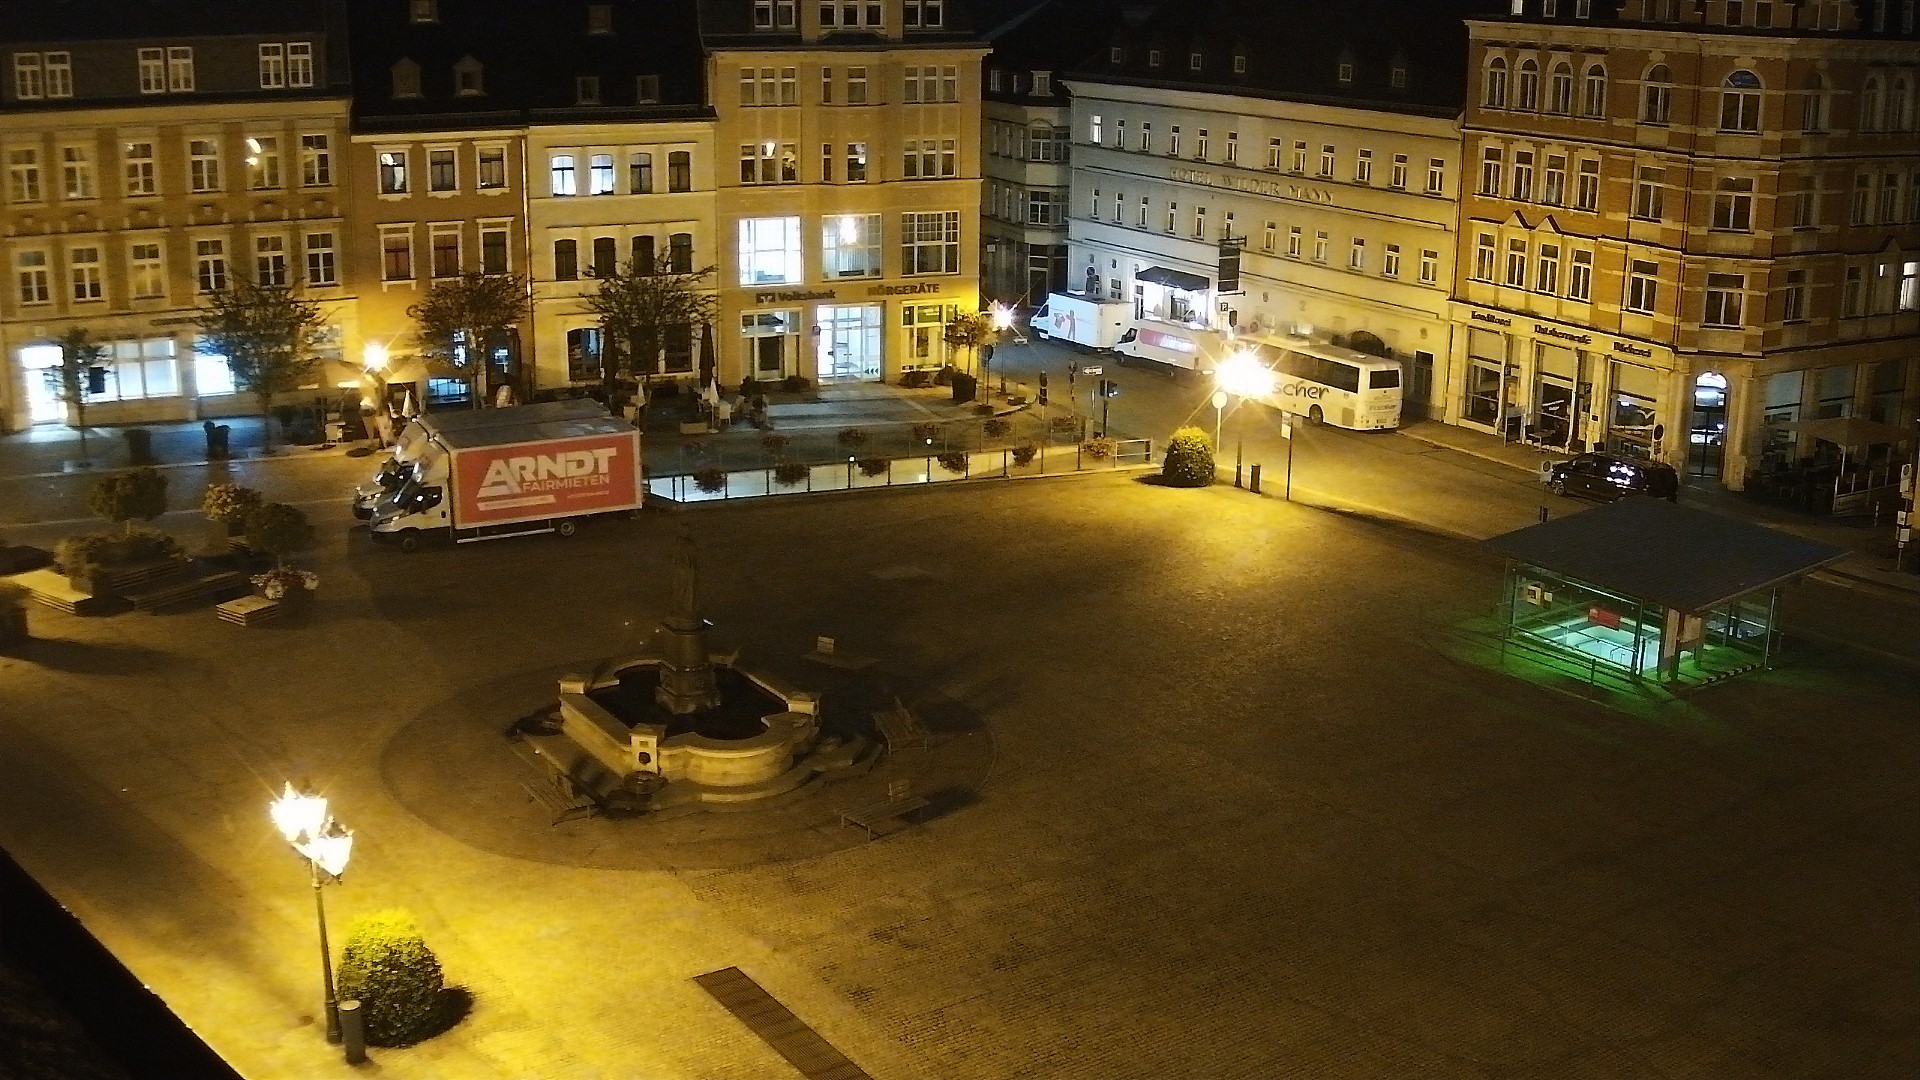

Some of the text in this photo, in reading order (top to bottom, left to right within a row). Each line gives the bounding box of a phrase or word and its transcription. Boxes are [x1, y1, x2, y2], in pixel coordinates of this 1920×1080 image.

[1170, 167, 1333, 204] HOTEL WILDER MANN
[778, 289, 836, 302] Volksbank
[867, 282, 940, 297] HÖRGERÄTE
[1271, 380, 1330, 400] scher
[477, 447, 617, 498] ARNDT
[523, 475, 610, 493] FAIRMIETEN
